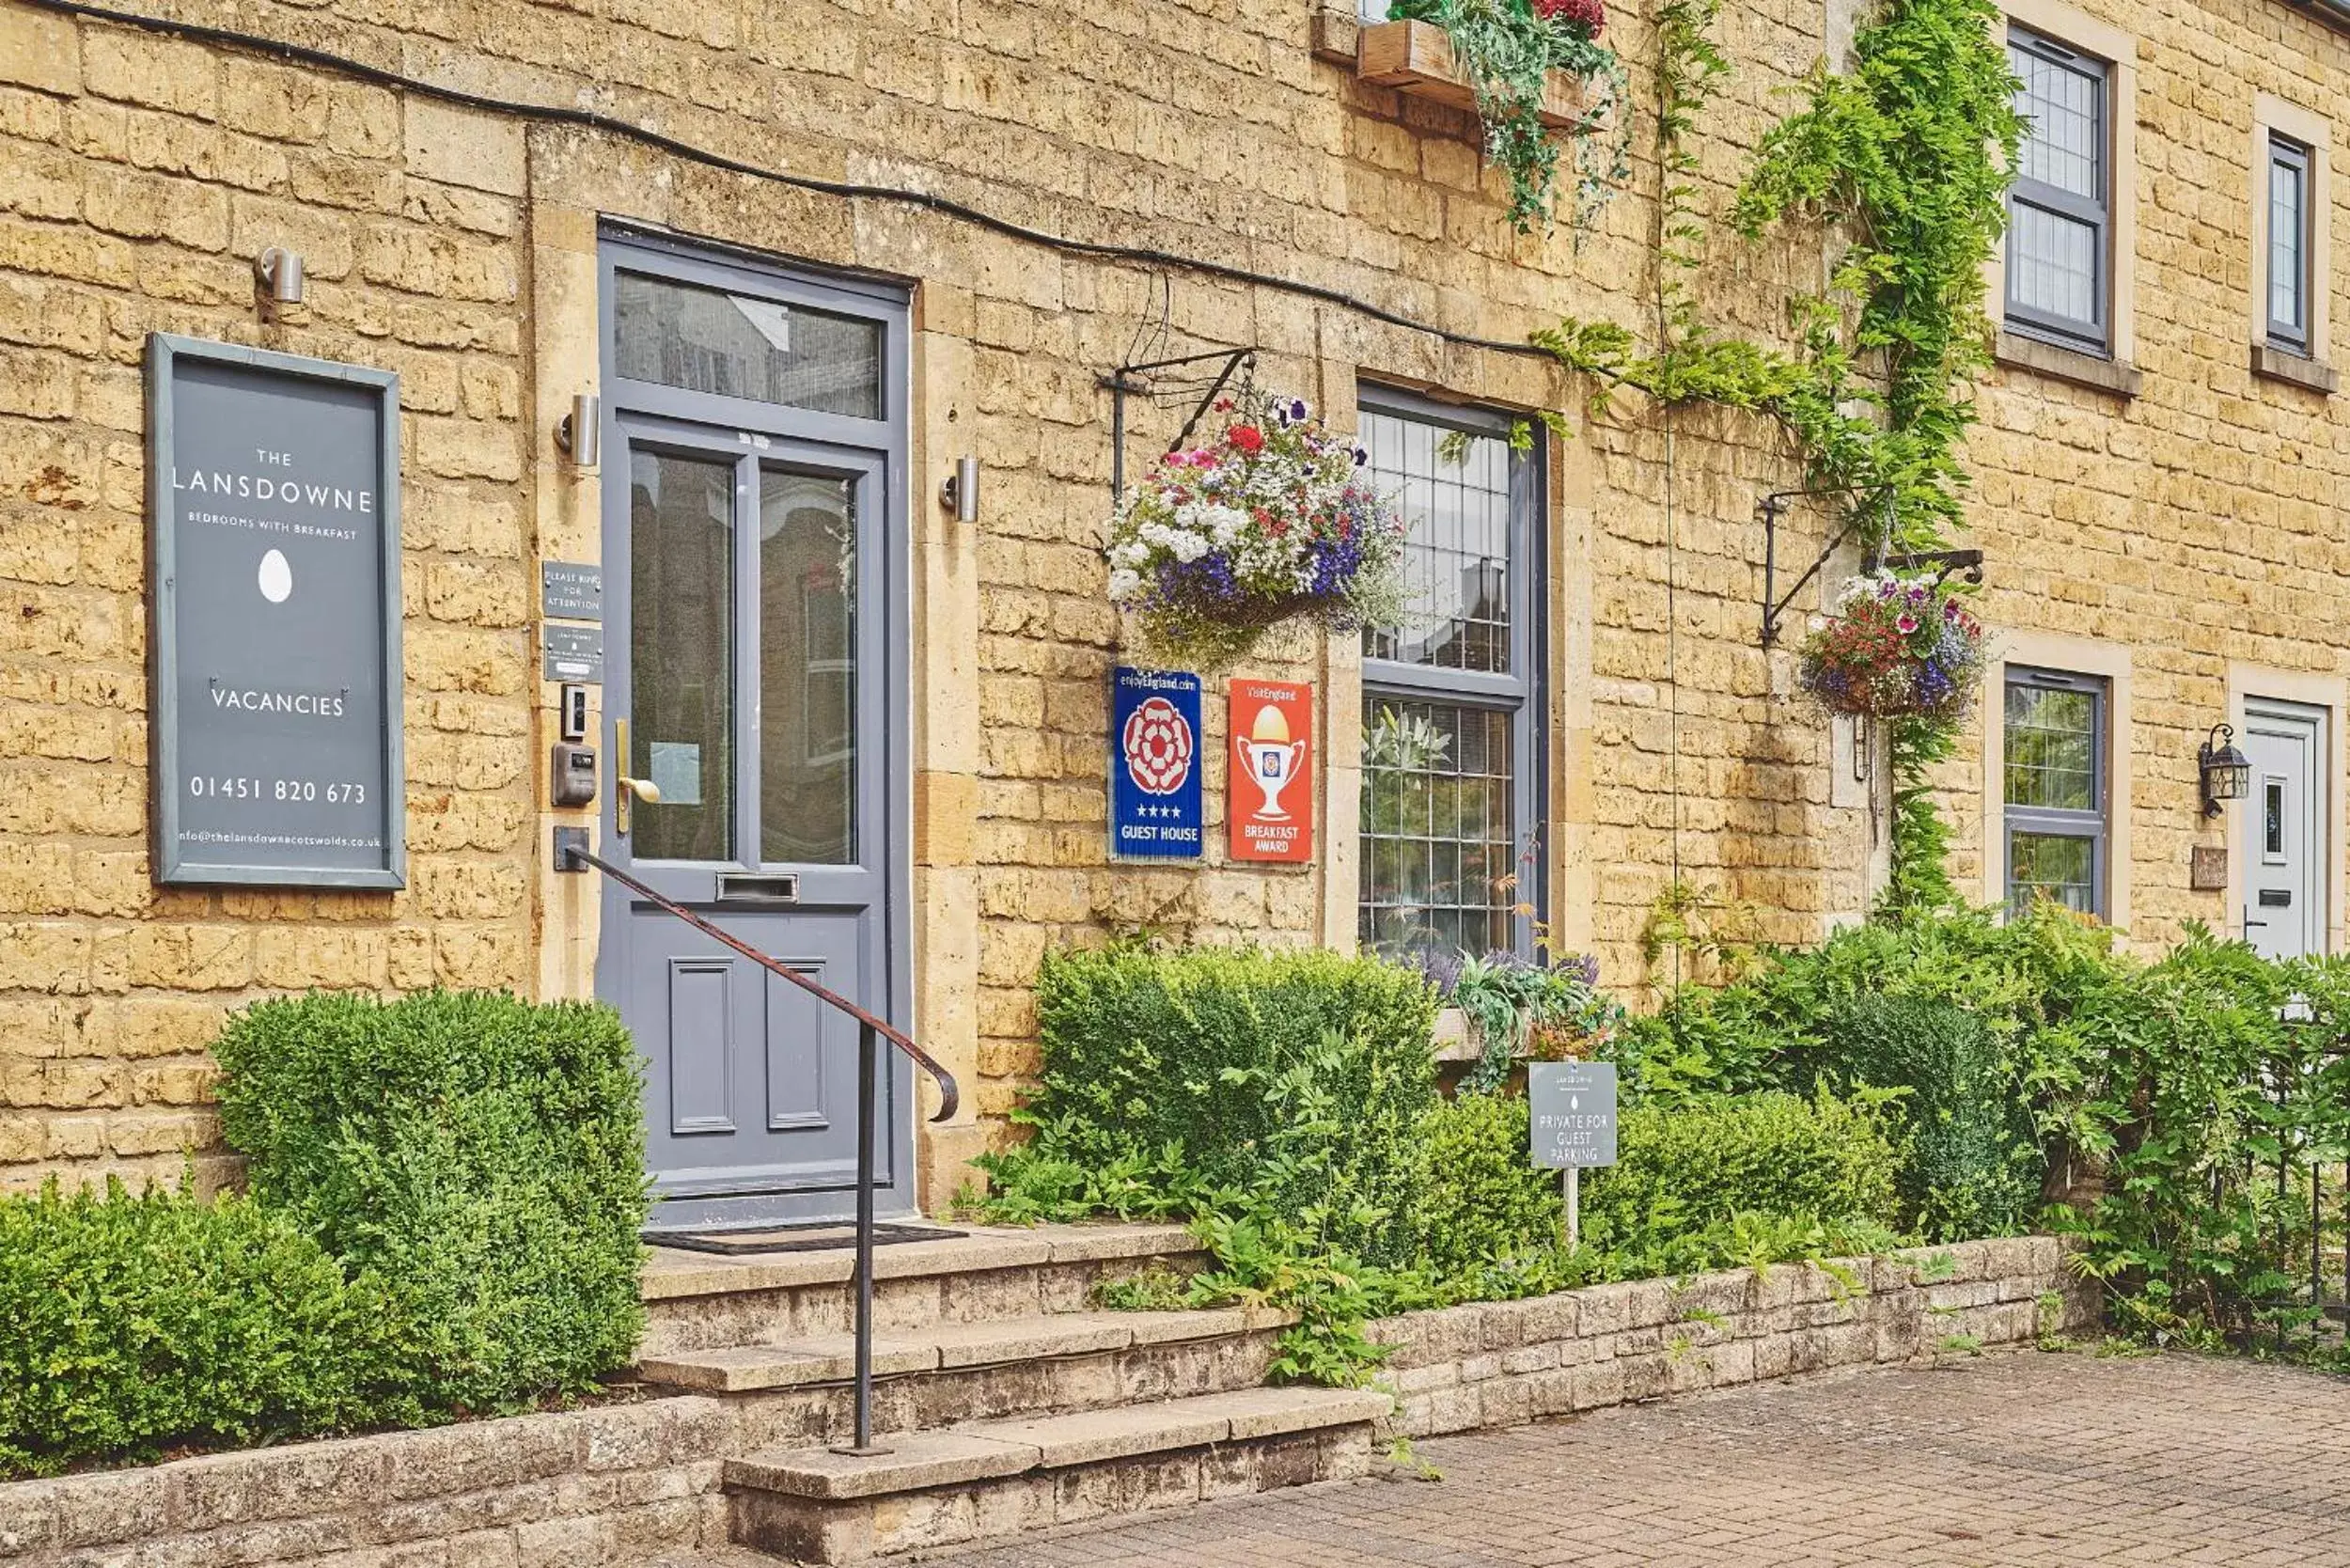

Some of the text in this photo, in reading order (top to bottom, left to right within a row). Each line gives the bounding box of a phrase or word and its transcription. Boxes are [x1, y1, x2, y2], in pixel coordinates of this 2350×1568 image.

[256, 448, 292, 466] THE
[172, 466, 372, 513] LANSDOWNE
[188, 510, 358, 541] BEDROOMS WITH BREAKFAST
[547, 597, 601, 611] ATTENTION
[1120, 674, 1197, 692] enjoyEngland.com
[211, 688, 344, 716] VACANCIES
[190, 776, 366, 805] 01451 820 673
[178, 829, 381, 847] nfo@thelansdownecotswolds.co.uk
[1121, 824, 1198, 841] GUEST HOUSE
[1245, 824, 1299, 839] BREAKFAST
[1255, 839, 1289, 854] AWARD
[1540, 1115, 1608, 1129] PRIVATE FOR
[1557, 1132, 1592, 1145] GUEST
[1550, 1148, 1598, 1163] PARKING
